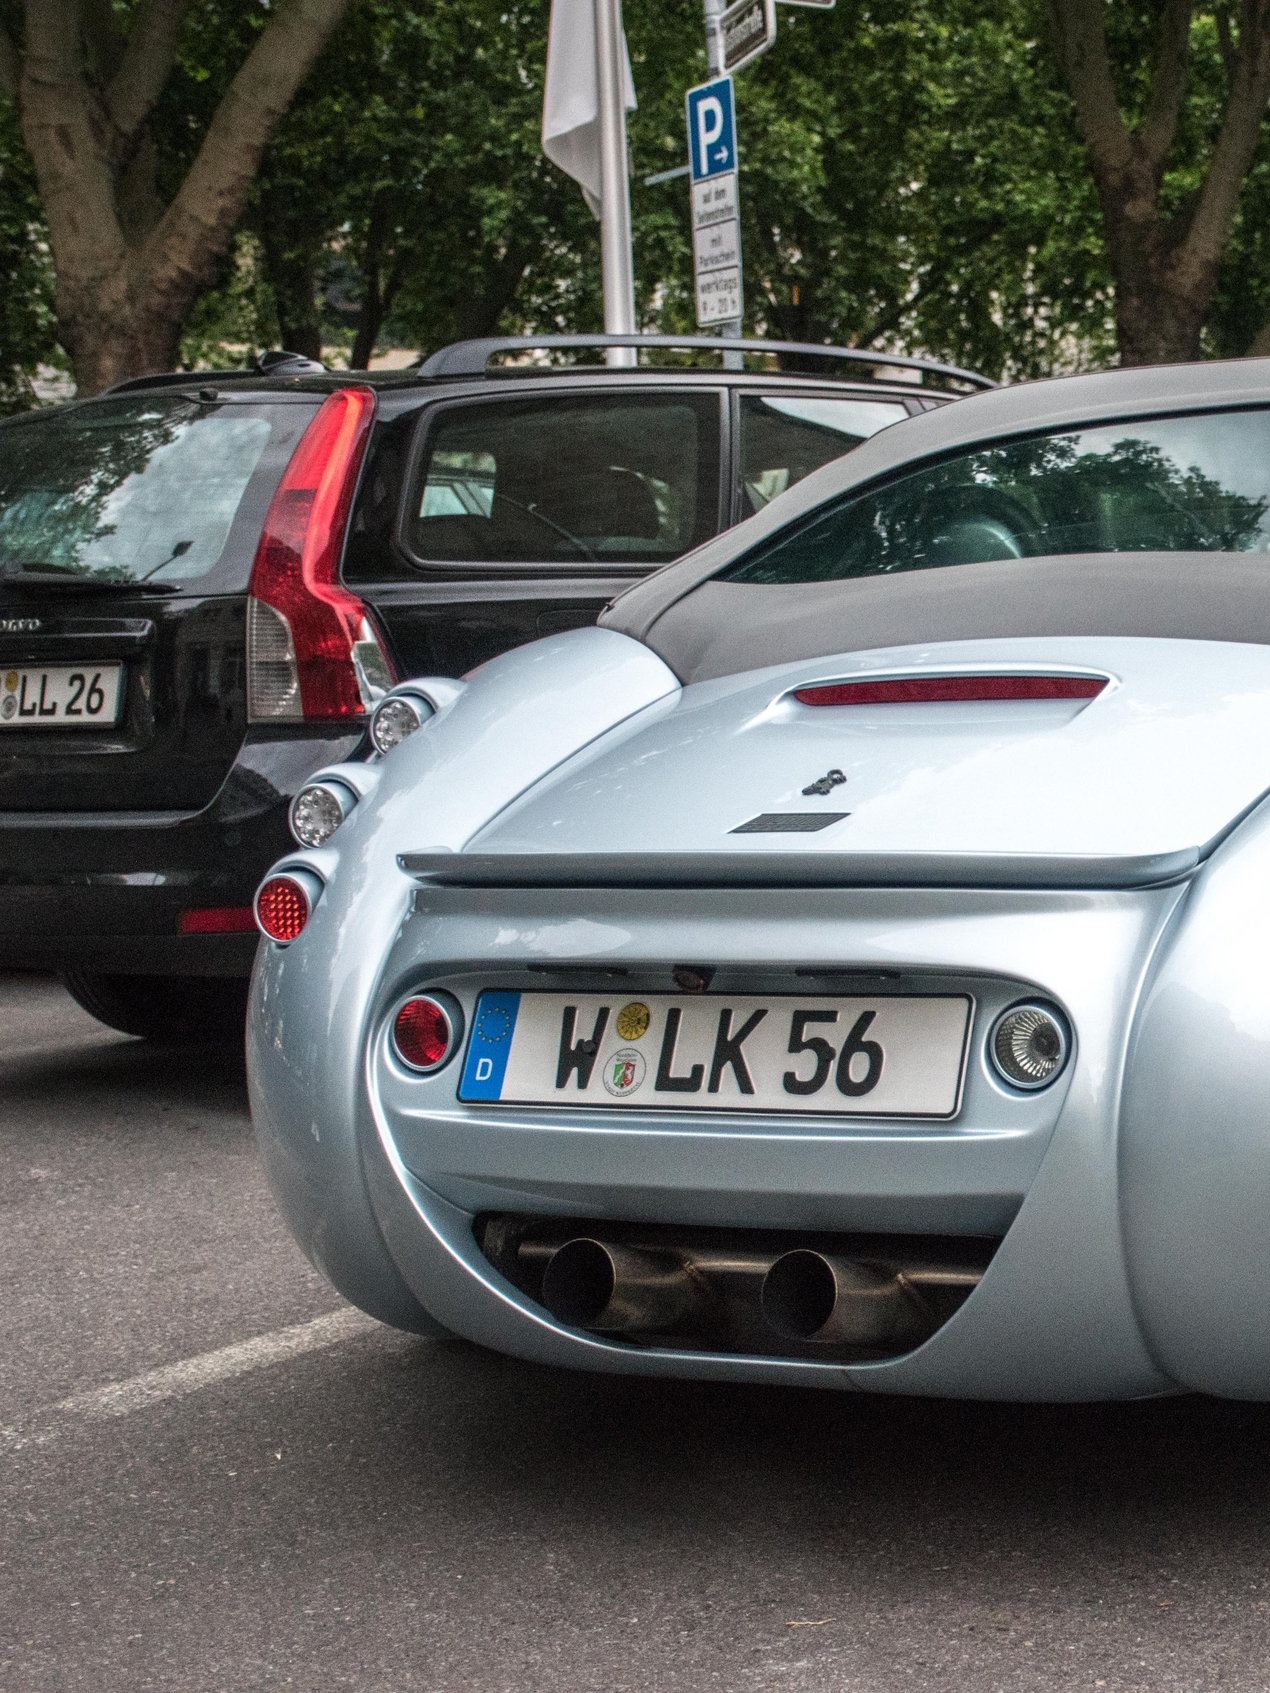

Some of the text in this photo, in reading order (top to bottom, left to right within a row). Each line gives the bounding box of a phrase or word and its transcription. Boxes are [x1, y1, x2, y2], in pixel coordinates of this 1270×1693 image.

[696, 96, 723, 175] P
[700, 277, 738, 295] werktags
[19, 672, 105, 716] LL 26
[475, 1058, 494, 1081] D
[555, 1006, 885, 1098] W LK 56
